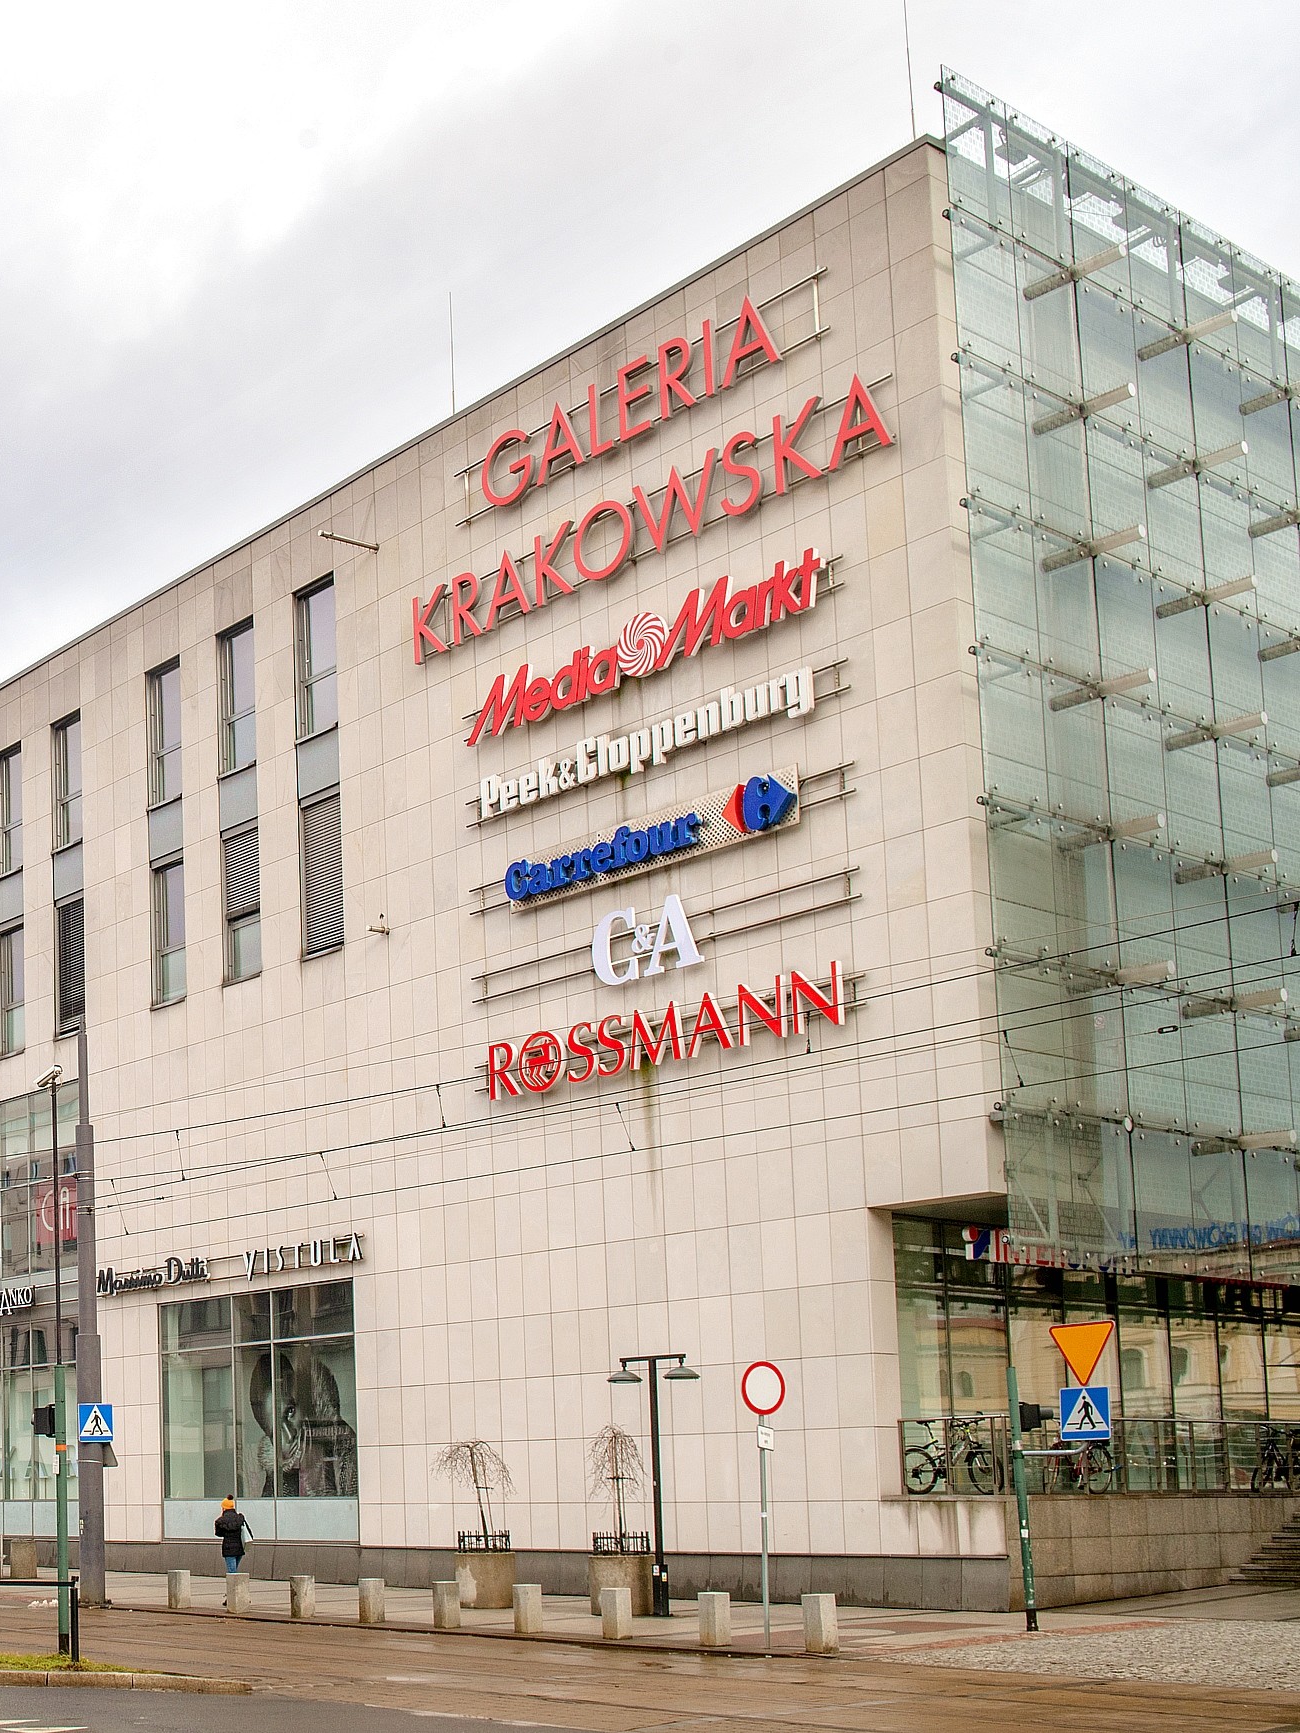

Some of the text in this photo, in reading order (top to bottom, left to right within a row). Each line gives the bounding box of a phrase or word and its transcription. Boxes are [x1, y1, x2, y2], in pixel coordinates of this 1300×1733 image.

[481, 295, 782, 507] GALERIA
[412, 373, 896, 665] KRAKOWSKA
[465, 547, 826, 747] Media Markt
[504, 811, 703, 900] Carrefour
[592, 894, 705, 987] C&A
[487, 960, 844, 1101] ROSSMANN
[97, 1256, 211, 1296] Massimo Dutti
[243, 1232, 364, 1281] VISTULA
